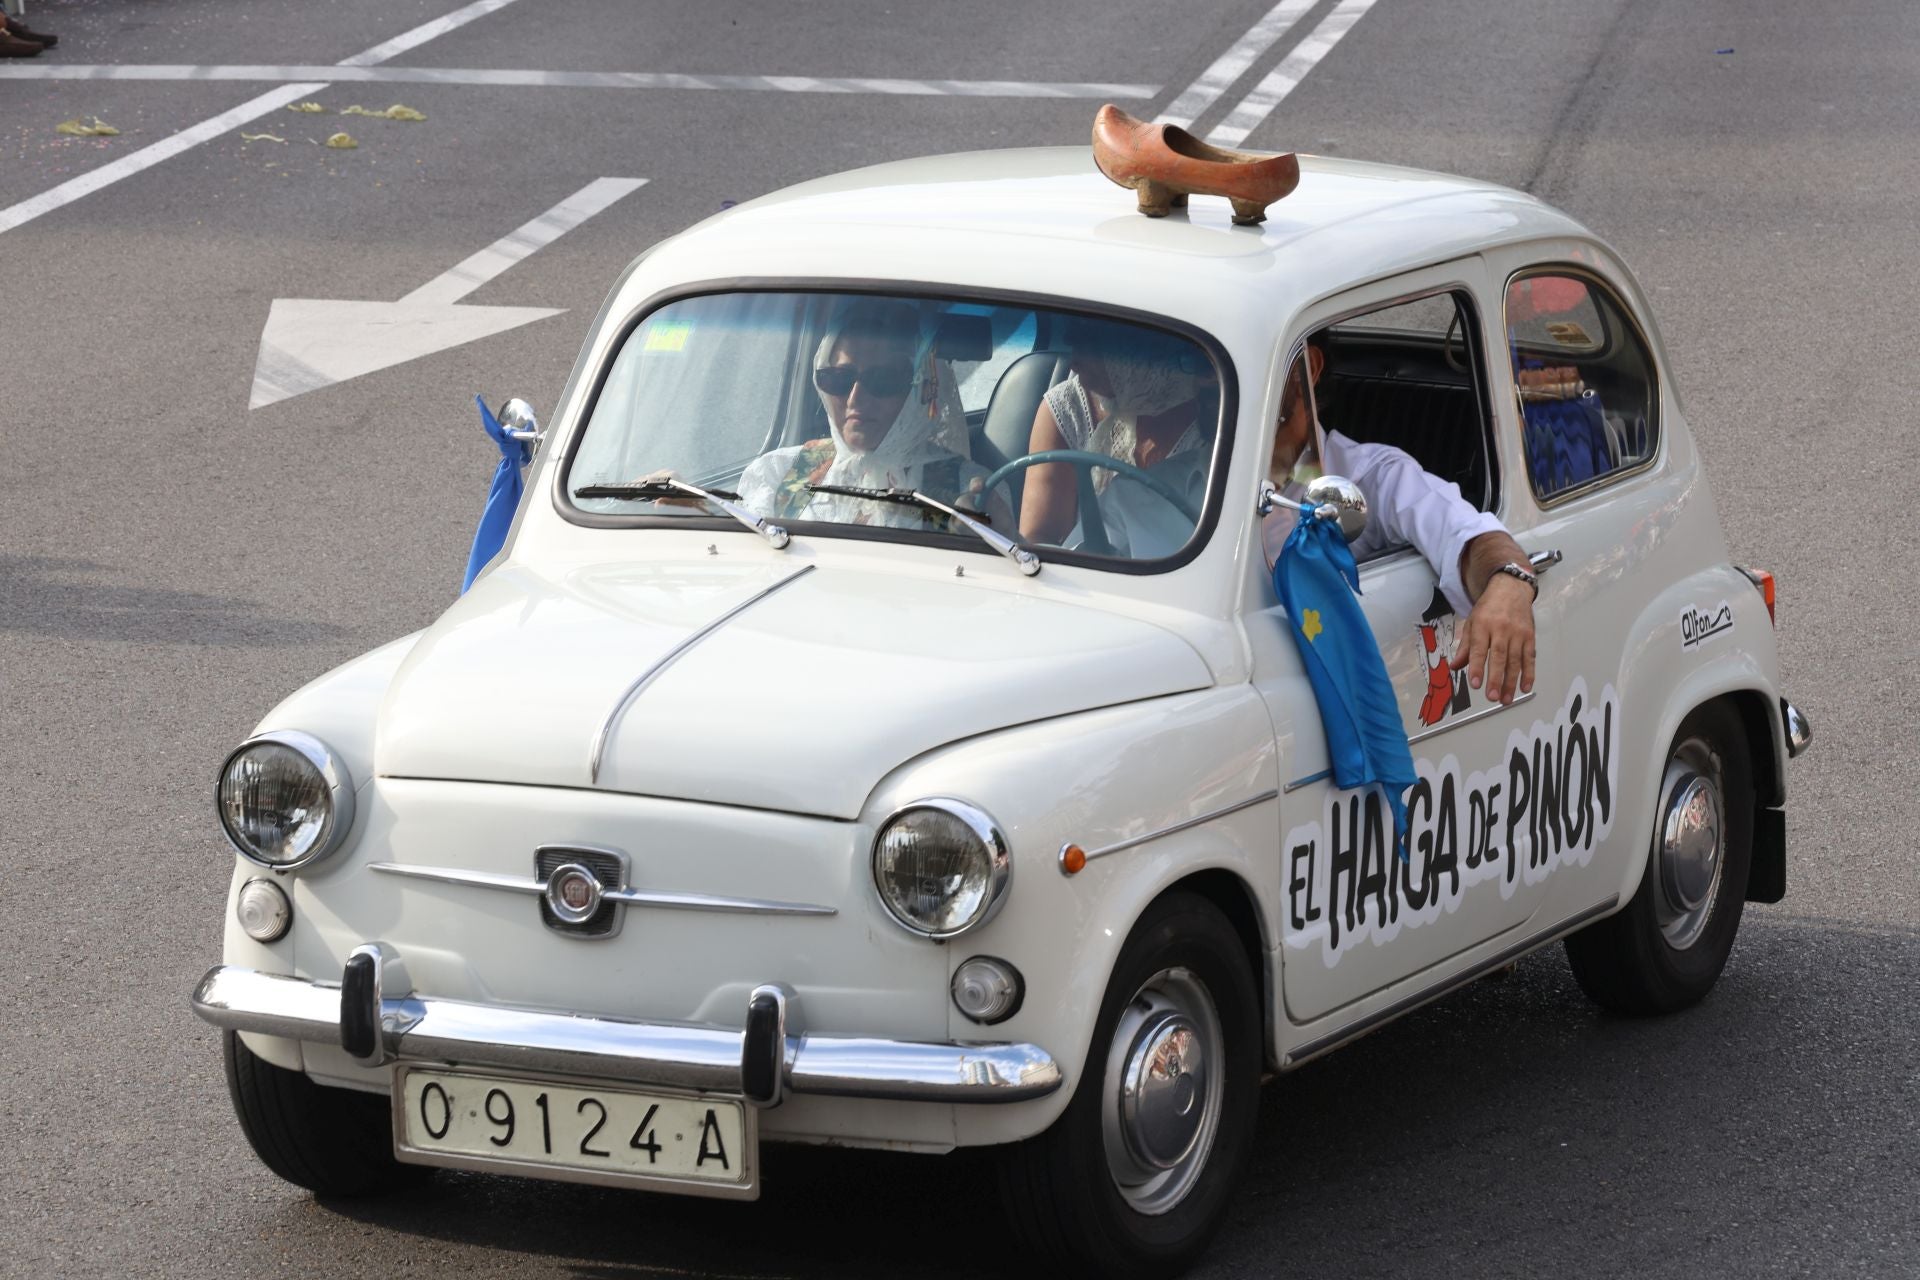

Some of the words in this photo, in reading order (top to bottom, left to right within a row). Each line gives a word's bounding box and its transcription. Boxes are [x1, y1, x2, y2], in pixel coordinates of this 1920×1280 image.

[1289, 839, 1321, 931] EL
[1465, 783, 1502, 869] DE
[1506, 693, 1612, 884] PINÓN
